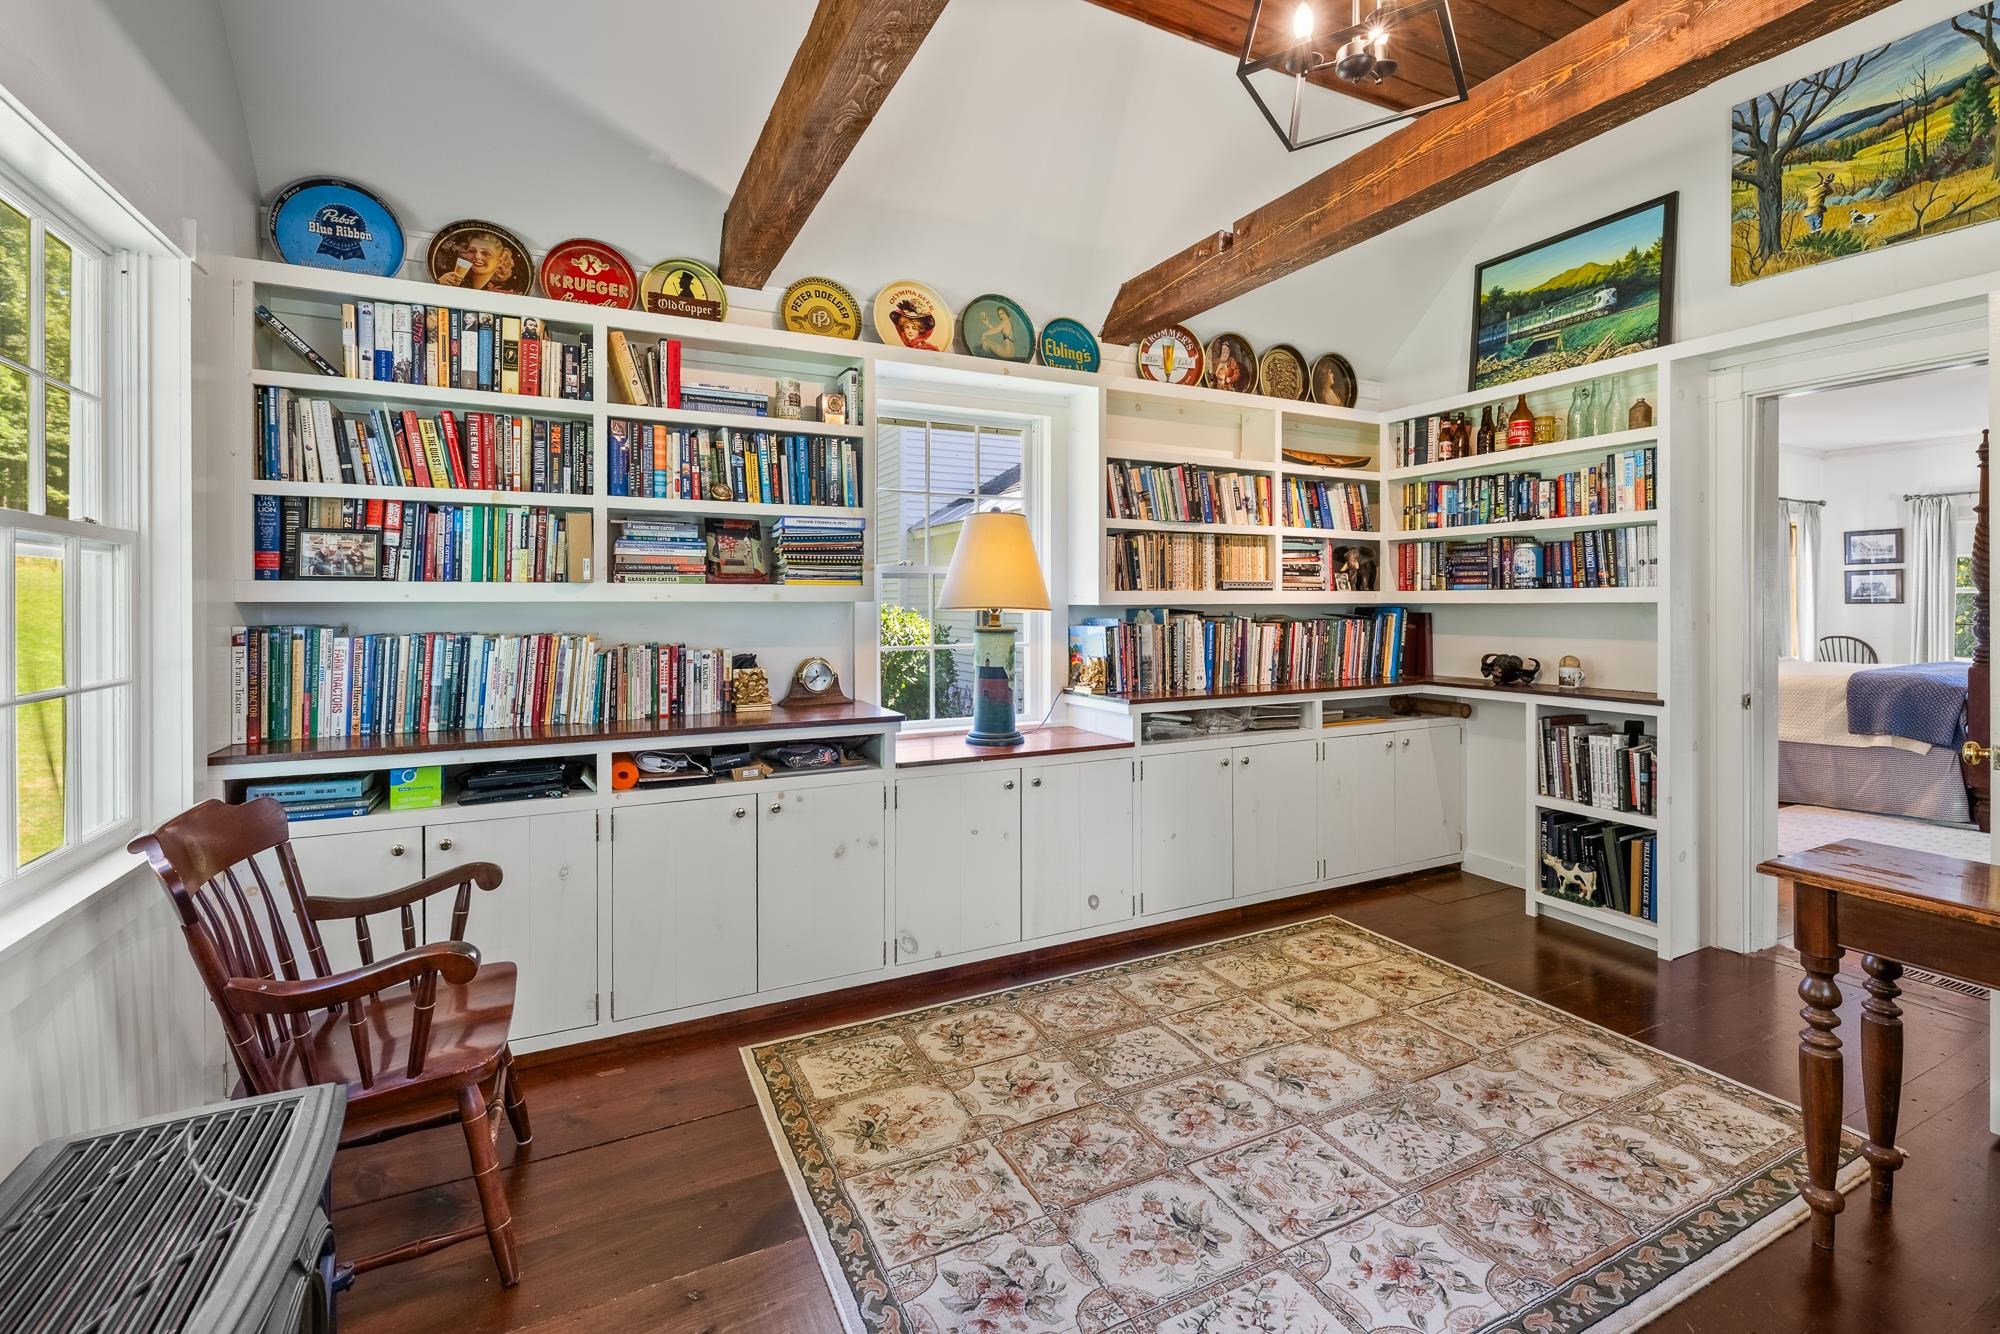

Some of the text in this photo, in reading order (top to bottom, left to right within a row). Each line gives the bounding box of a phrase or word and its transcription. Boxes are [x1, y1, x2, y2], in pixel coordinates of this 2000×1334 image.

[308, 221, 372, 241] Blue Ribbon
[322, 208, 359, 226] Pabst
[550, 273, 630, 299] KRUEGER
[889, 289, 917, 304] OLYMPIA
[657, 298, 713, 316] Old Topper
[791, 290, 850, 320] PETER DOELGER
[412, 323, 423, 344] 1776
[1145, 328, 1194, 352] TROMMER'S
[528, 344, 538, 384] GRANT
[1044, 338, 1092, 364] Ebling's
[411, 432, 424, 467] ECONOMICS
[428, 436, 440, 466] THE QUEST
[470, 422, 480, 468] THE NEW MAP
[551, 426, 561, 454] PRIZE
[1585, 533, 1595, 568] DAVID BALDACCI
[249, 648, 257, 685] AMERICAN
[332, 649, 344, 714] FARM TRACTORS
[354, 652, 362, 689] International
[235, 650, 244, 714] The Farm Tractor
[249, 687, 257, 718] TRACTOR
[353, 689, 361, 716] Harvester
